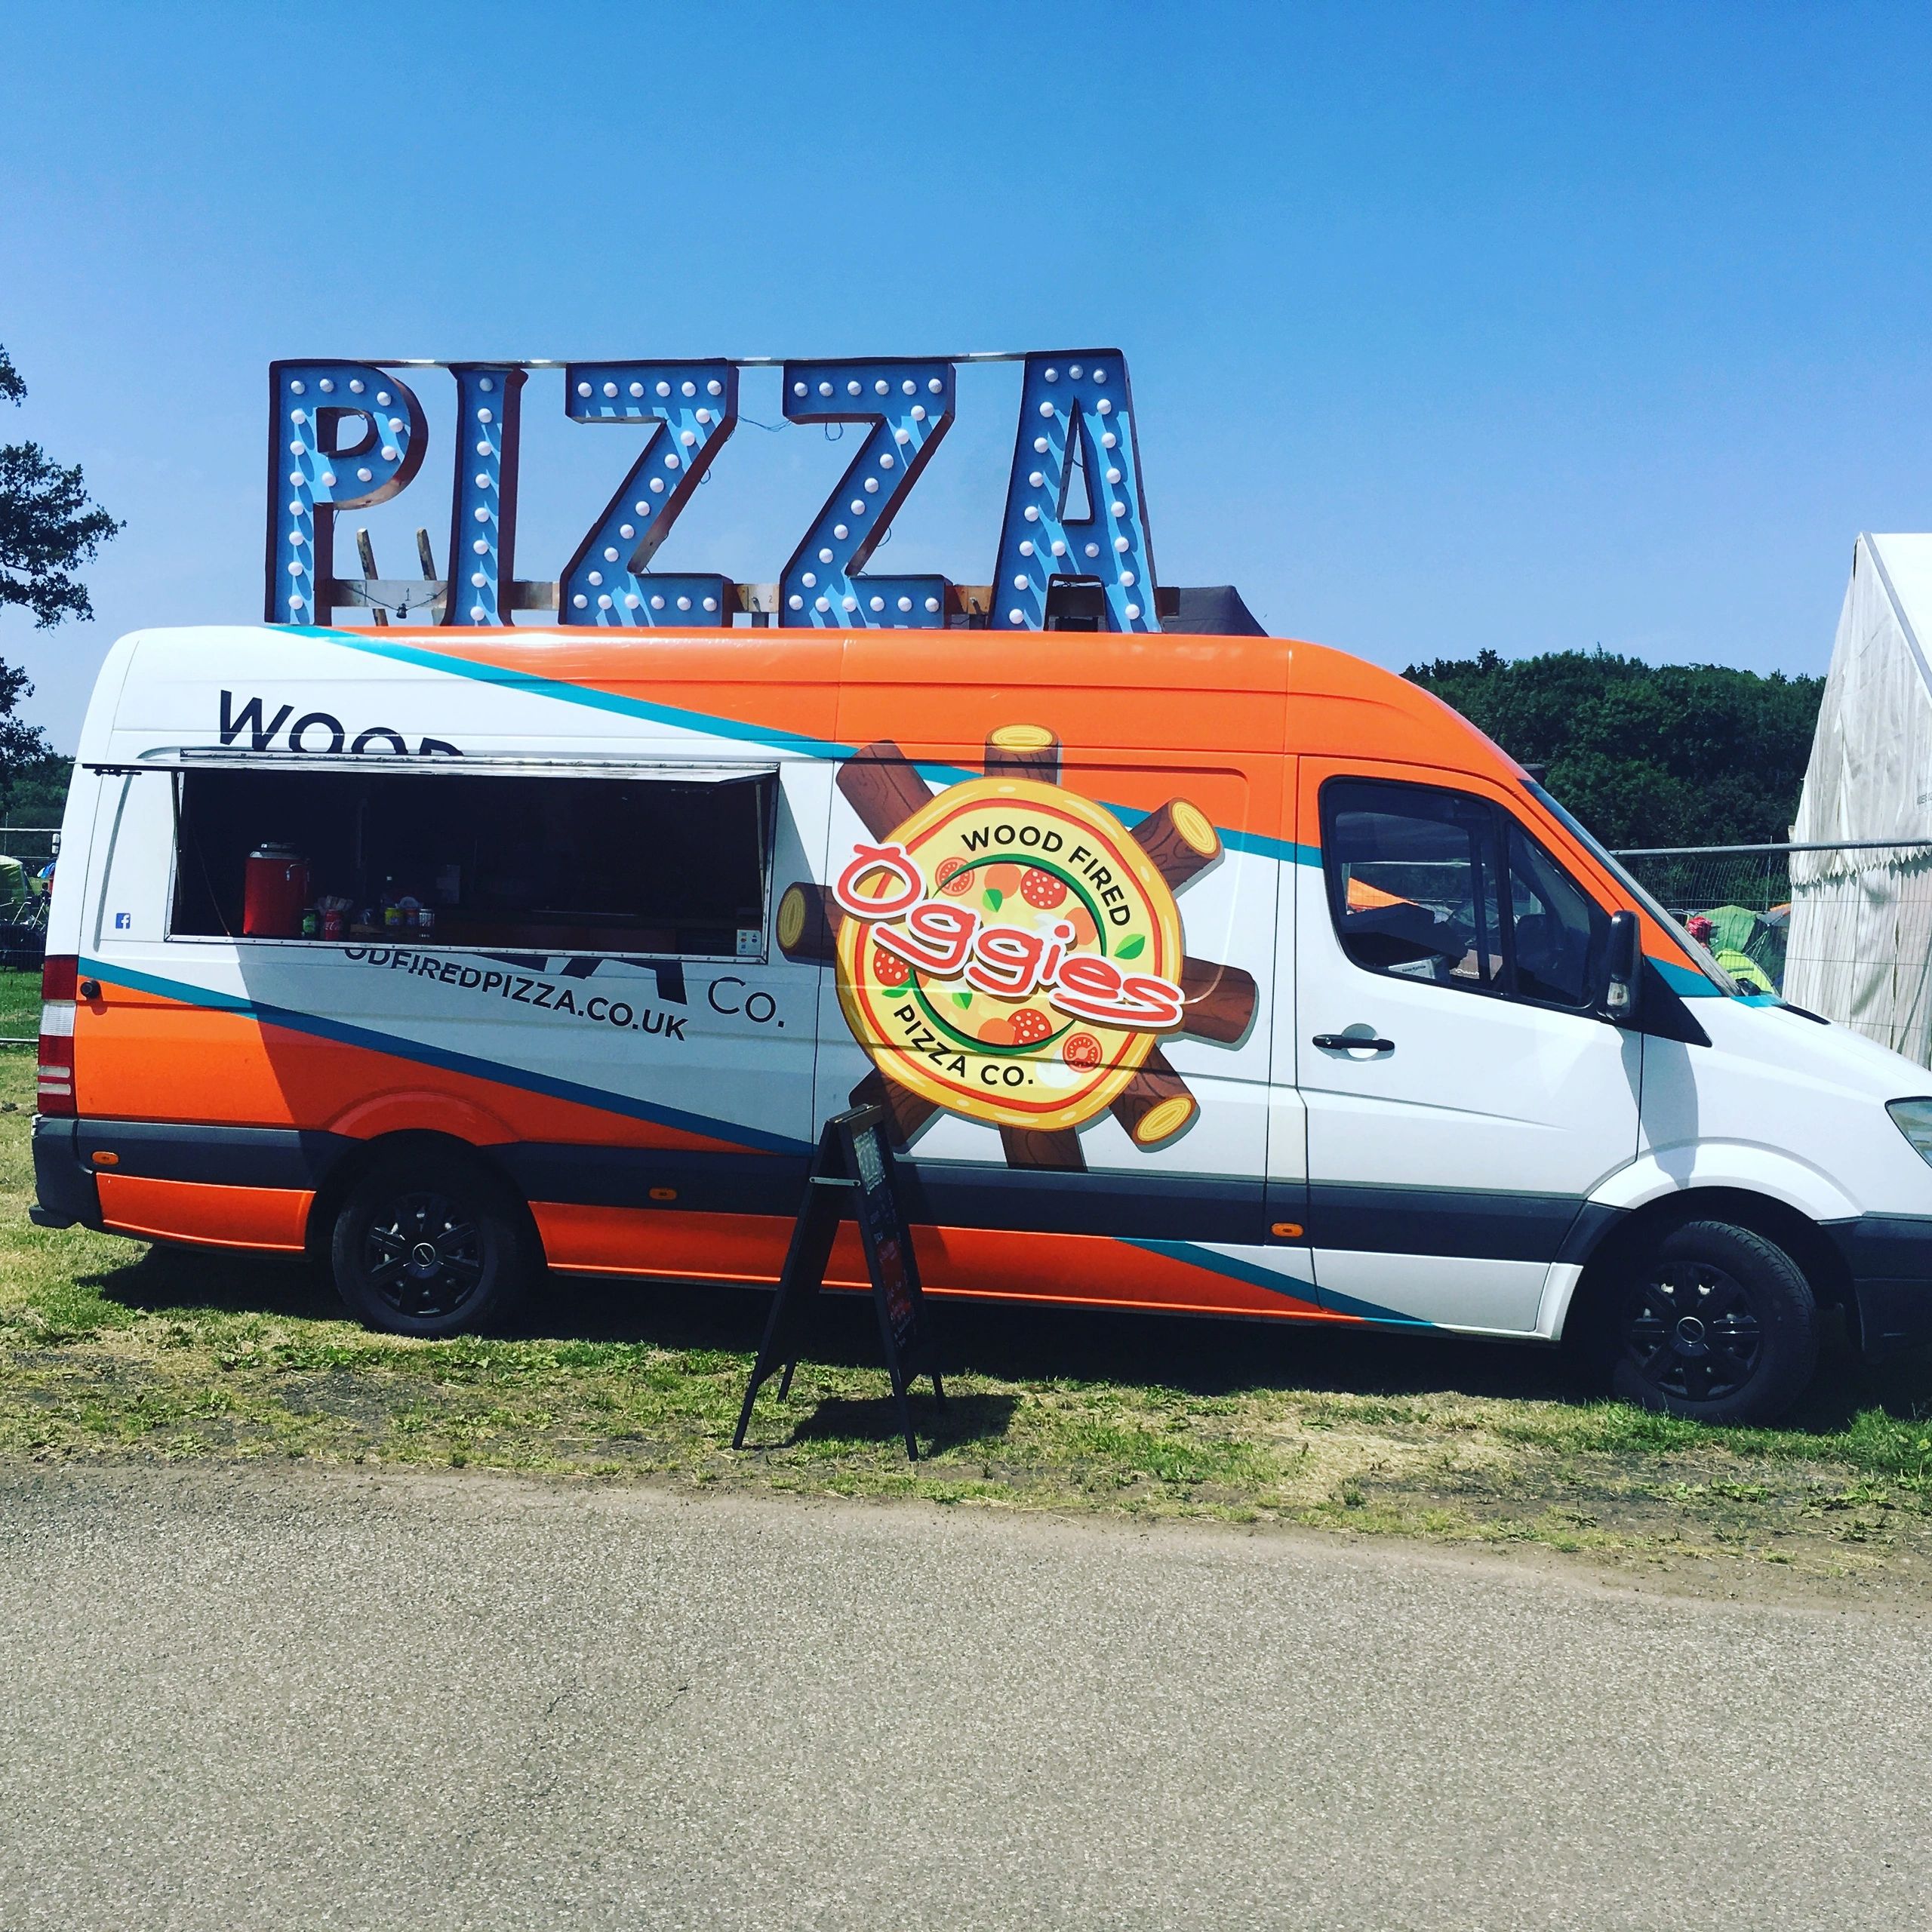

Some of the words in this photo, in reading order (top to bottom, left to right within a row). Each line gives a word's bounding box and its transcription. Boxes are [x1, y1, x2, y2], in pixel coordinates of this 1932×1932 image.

[266, 348, 1161, 633] PIZZA
[835, 842, 1184, 1024] Oggies
[961, 824, 1063, 853] WOOD
[1068, 845, 1131, 926] FIRED
[893, 1004, 966, 1078] PIZZA
[980, 1064, 1033, 1087] CO.
